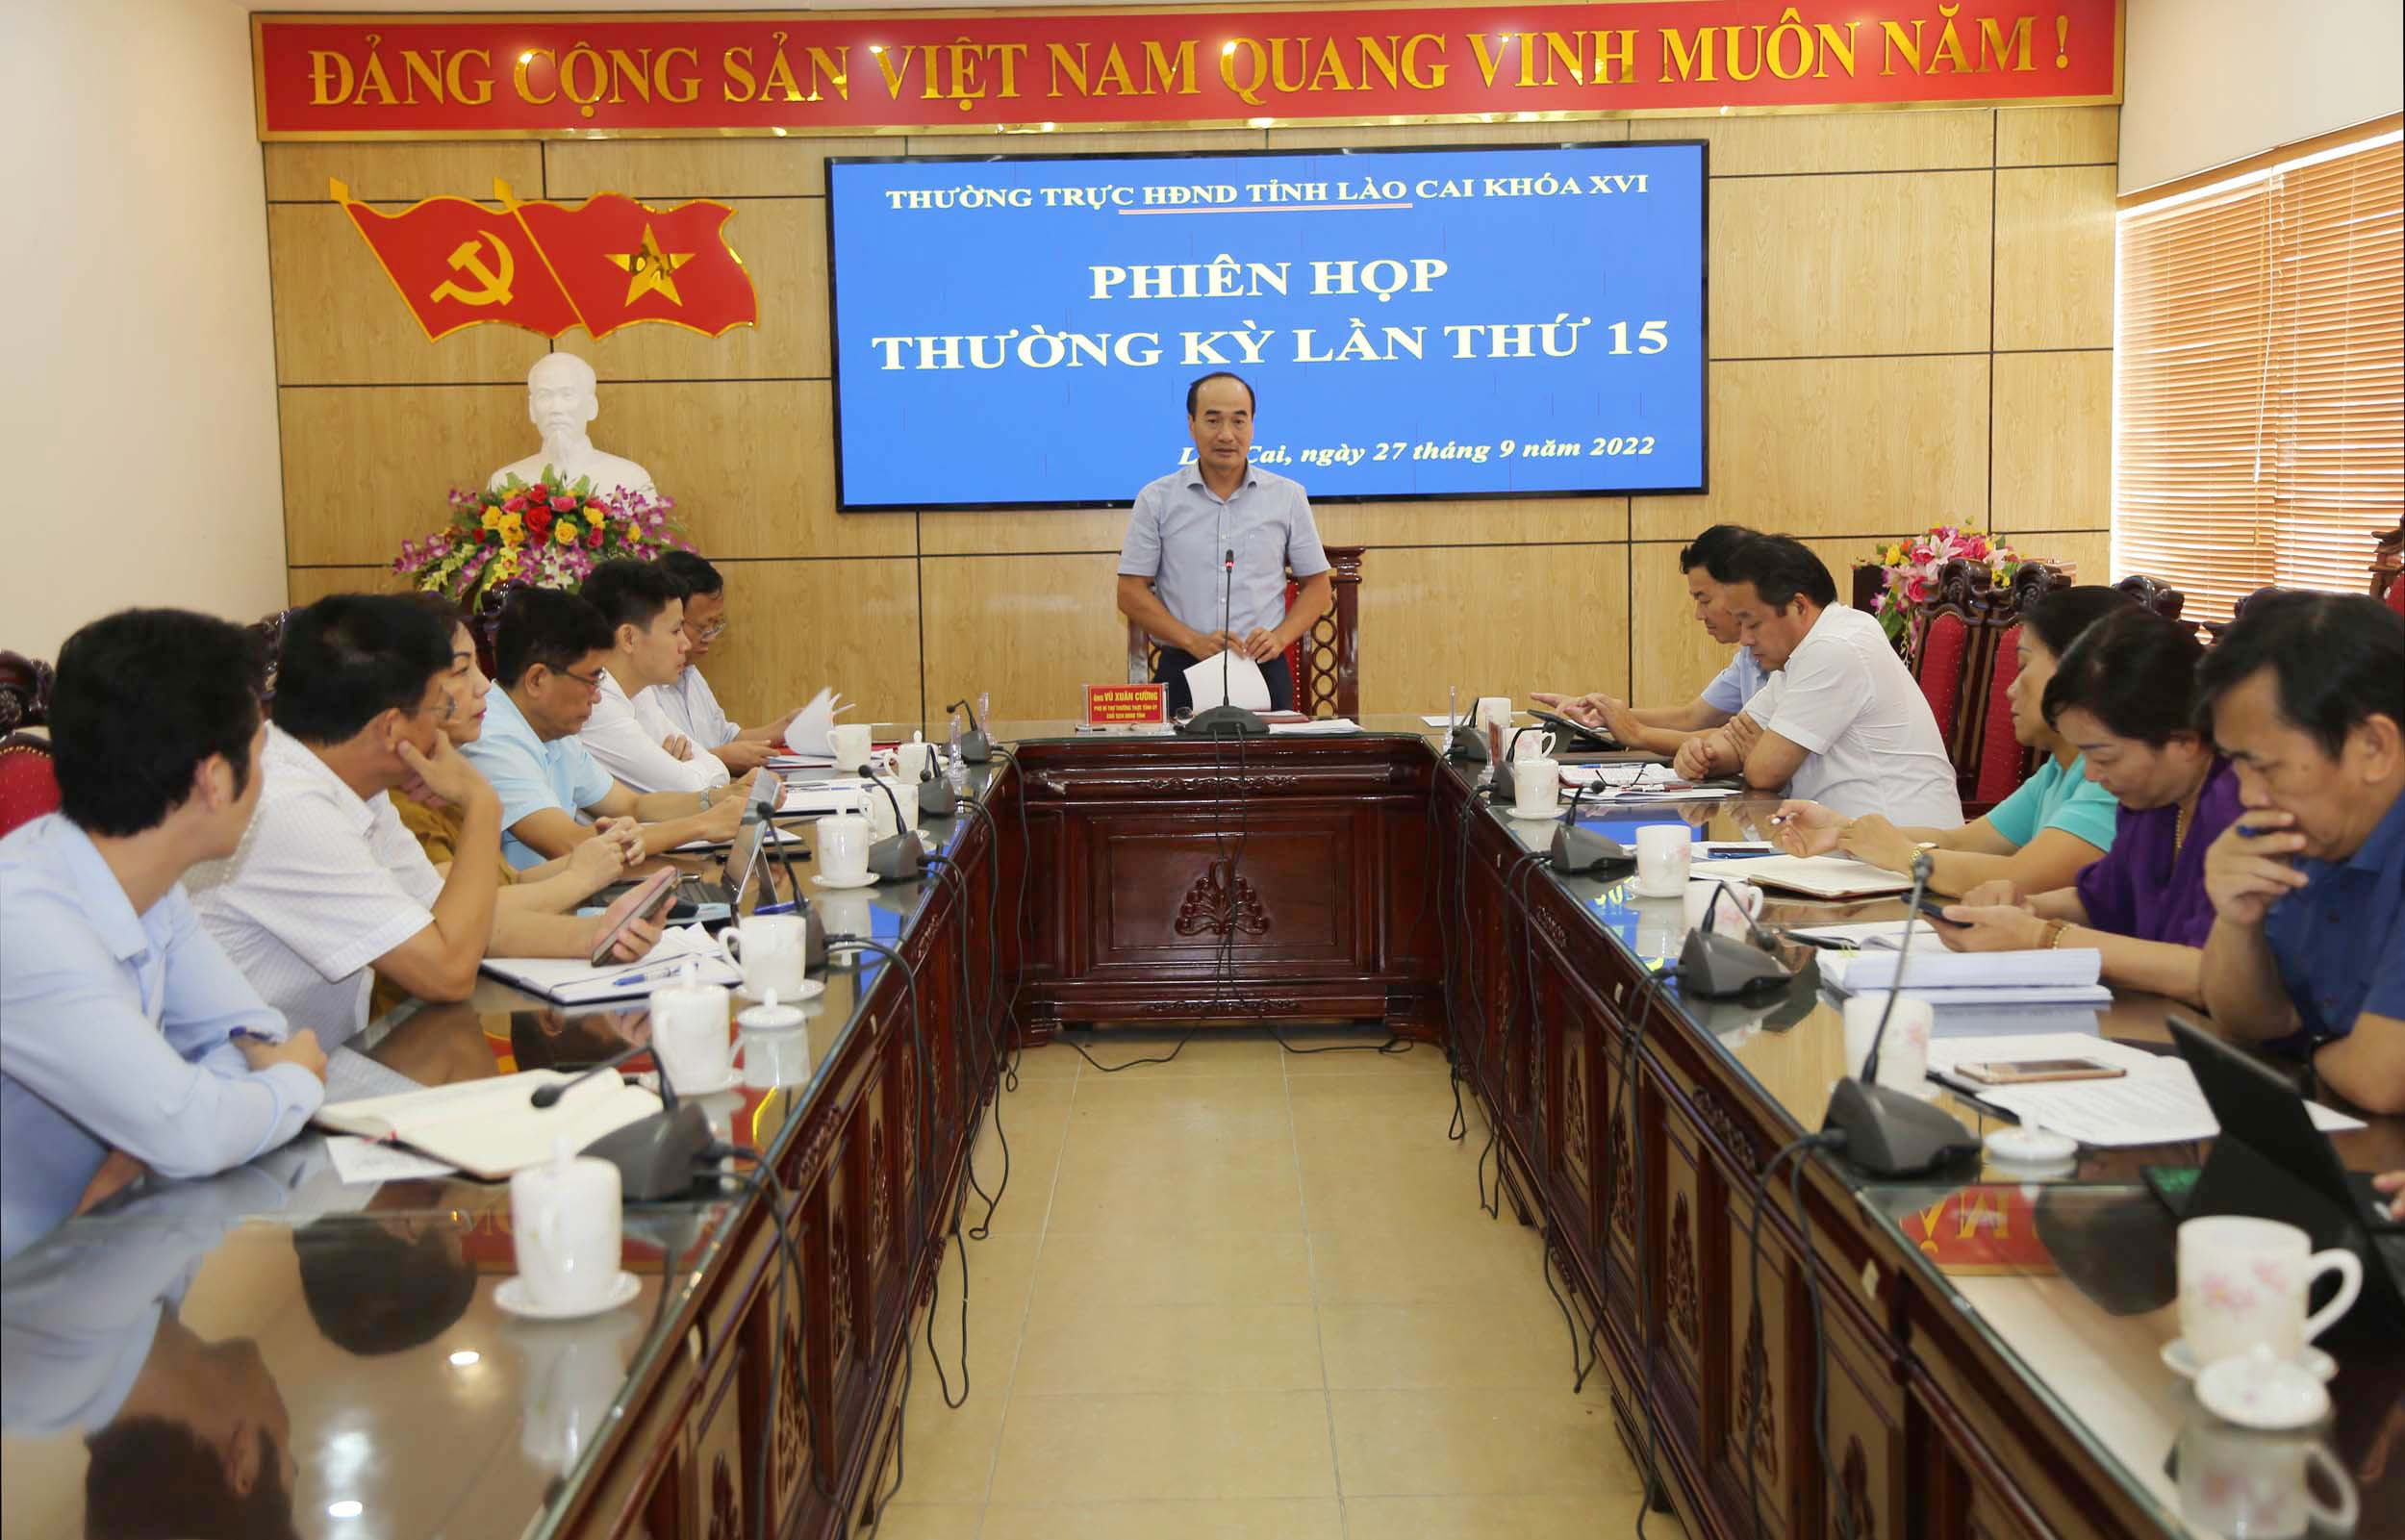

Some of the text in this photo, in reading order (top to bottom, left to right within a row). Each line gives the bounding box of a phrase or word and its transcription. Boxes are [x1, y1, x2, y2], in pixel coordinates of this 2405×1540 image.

[310, 34, 493, 106] ĐẢNG
[513, 42, 702, 117] CỘNG
[723, 32, 850, 103] SẢN
[870, 37, 1027, 112] VIỆT
[1046, 39, 1202, 97] NAM
[1219, 34, 1451, 106] QUANG
[1466, 30, 1639, 88] VINH
[1658, 7, 1860, 84] MUÔN
[1880, 3, 2038, 74] NĂM
[886, 172, 1649, 210] THƯỜNG TRỰC HĐND TỈNH LÀO CAI KHÓA XVI
[1088, 253, 1449, 303] PHIÊN HỌP
[872, 313, 1669, 370] THƯỜNG KỲ LẦN THỨ 15
[1301, 443, 1366, 467] ngày
[1372, 442, 1408, 462] 27
[1412, 441, 1492, 464] tháng
[1499, 440, 1516, 459] 9
[1522, 439, 1582, 458] năm
[1589, 436, 1656, 456] 2022
